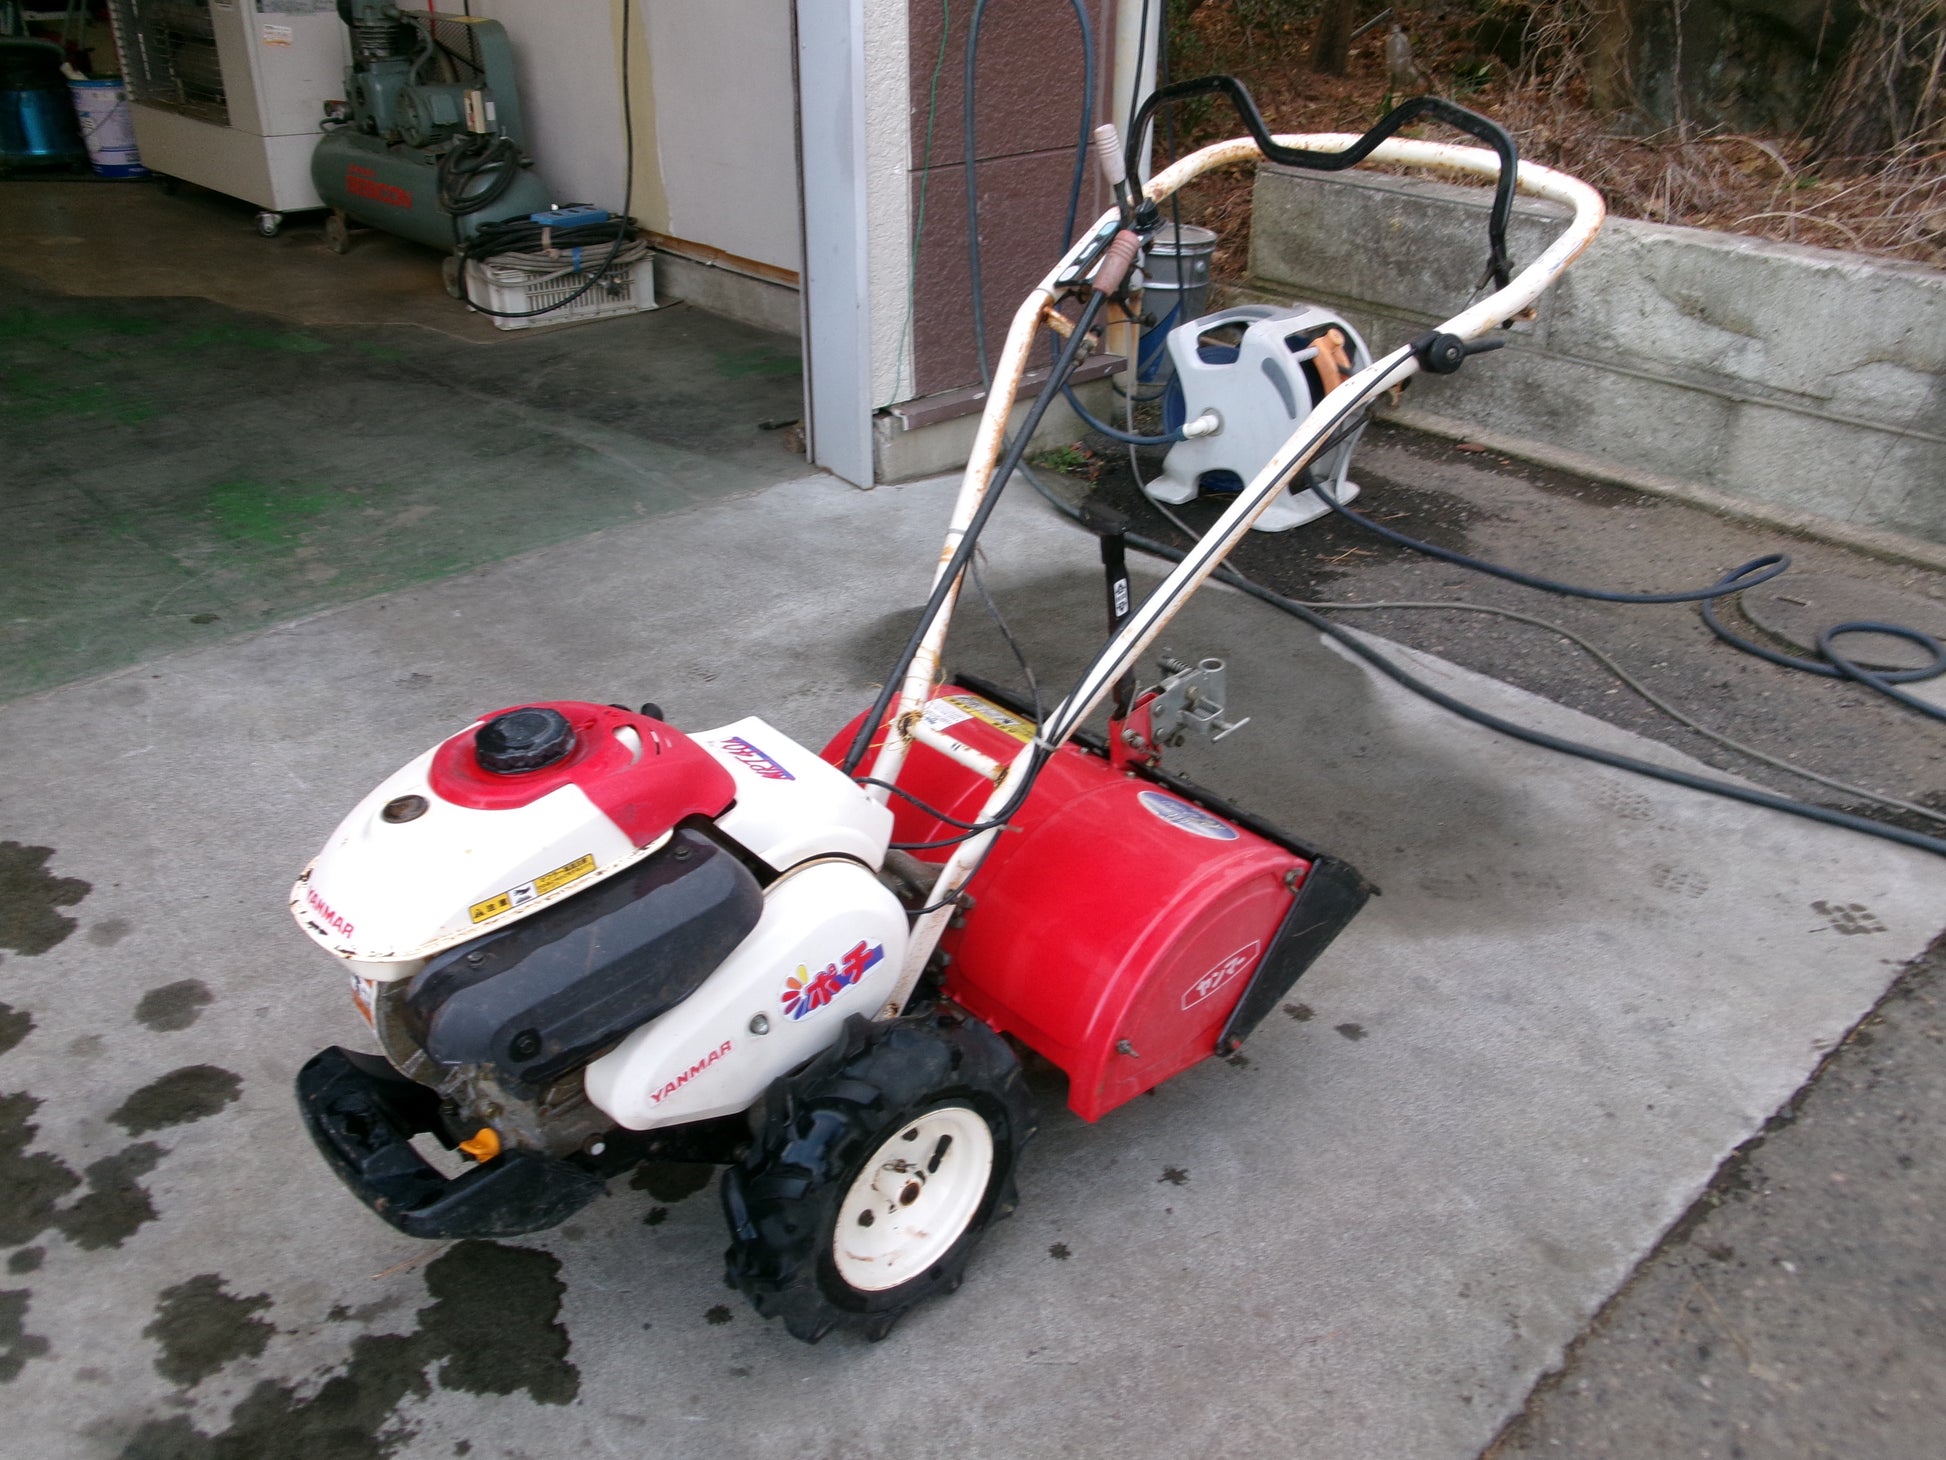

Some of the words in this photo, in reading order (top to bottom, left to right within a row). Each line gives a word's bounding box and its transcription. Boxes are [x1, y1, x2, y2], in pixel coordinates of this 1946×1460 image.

[308, 889, 354, 939] YANMAR
[1196, 956, 1246, 996] ヤンマー
[650, 1040, 732, 1102] YANMAR
